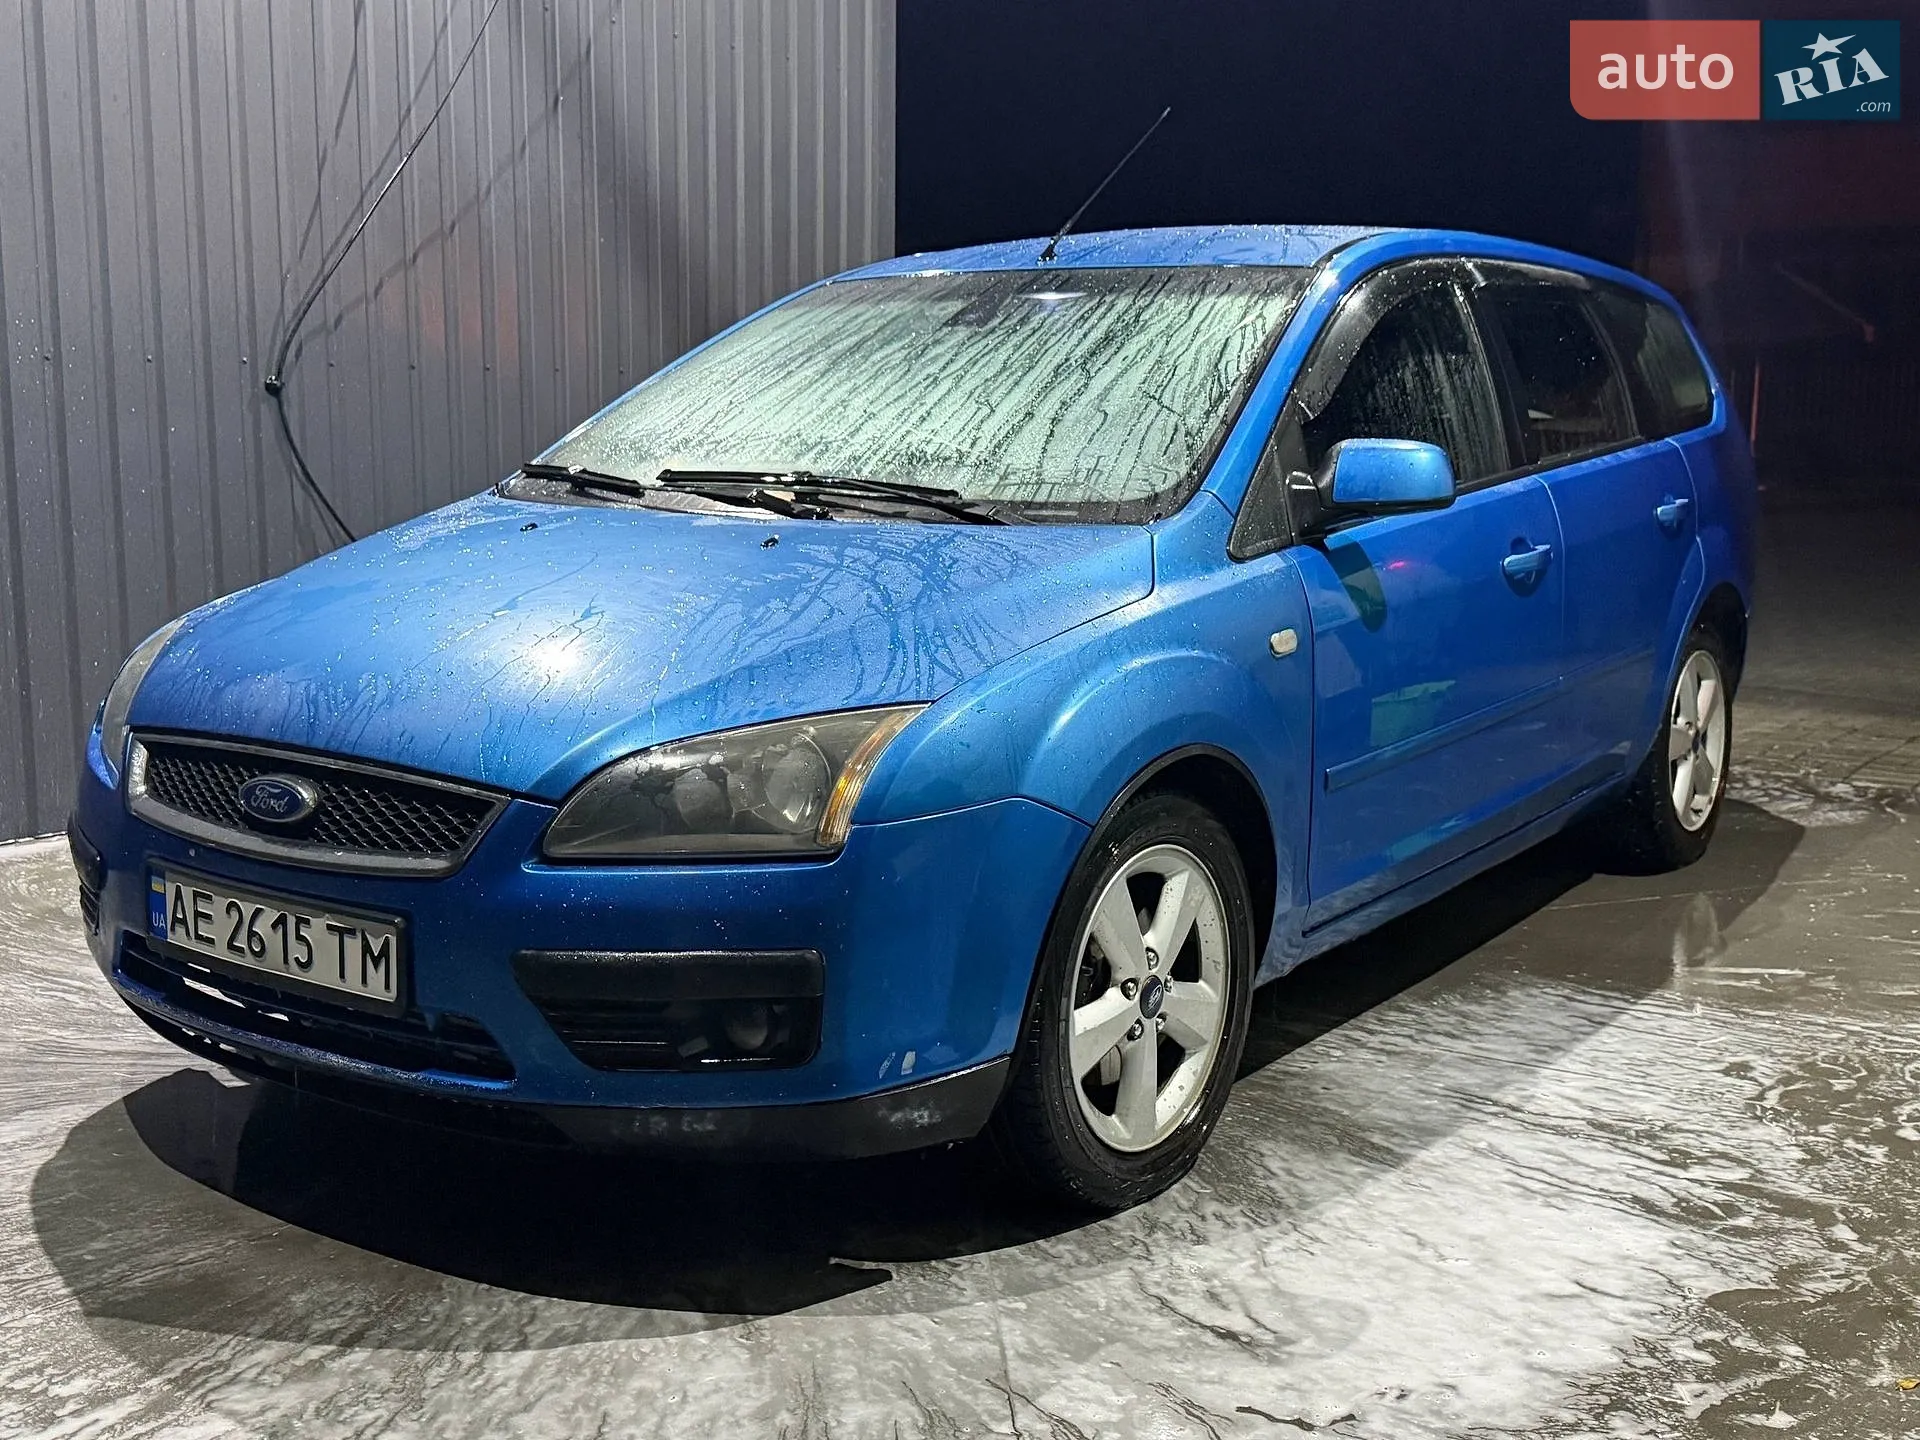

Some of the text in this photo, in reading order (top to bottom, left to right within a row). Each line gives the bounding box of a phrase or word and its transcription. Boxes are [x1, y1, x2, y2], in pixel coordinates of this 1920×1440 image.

[250, 784, 290, 813] Ford
[151, 911, 167, 930] UA
[169, 882, 392, 993] AE 2615 TM
